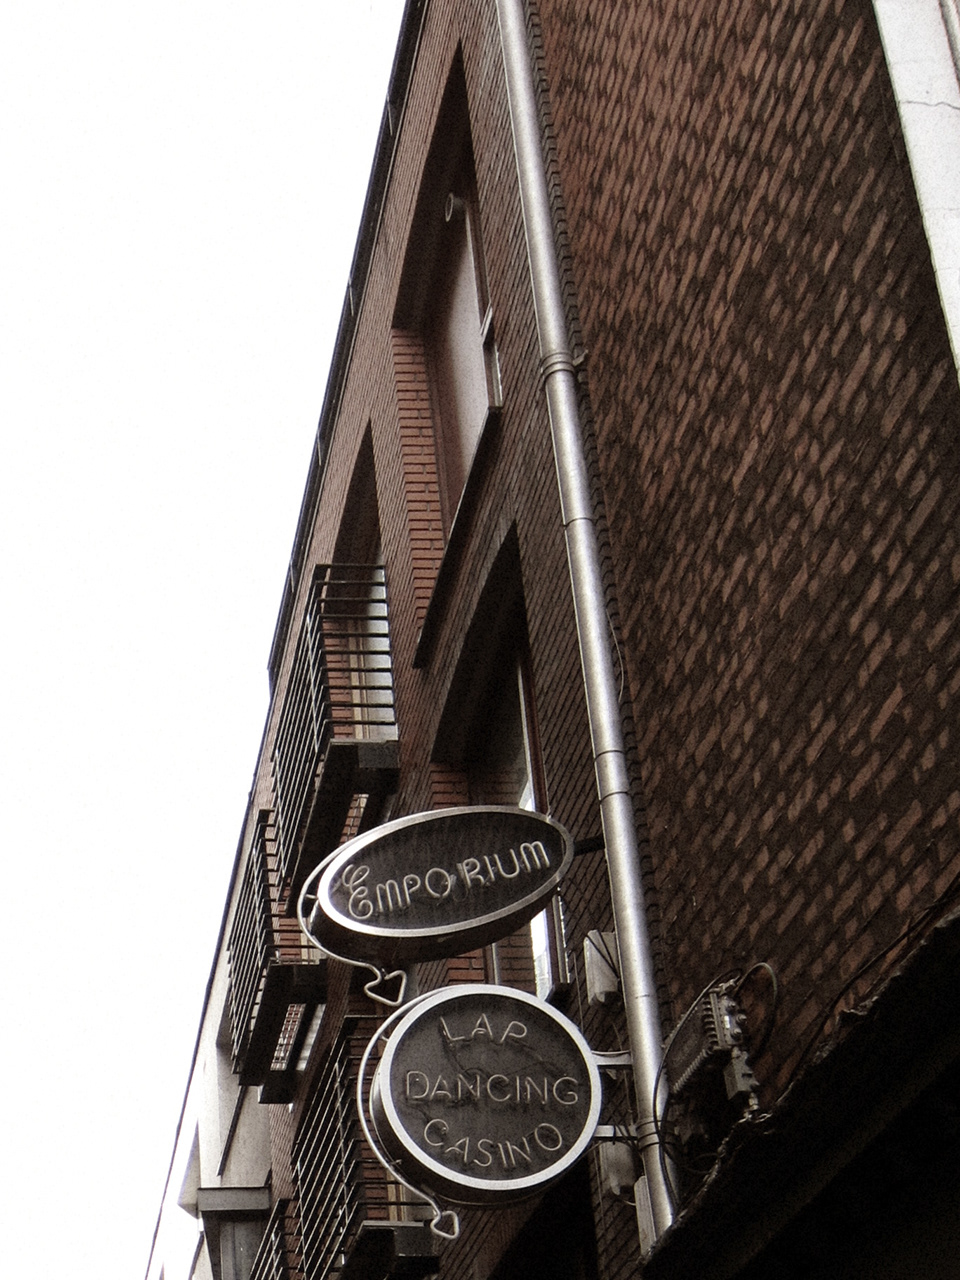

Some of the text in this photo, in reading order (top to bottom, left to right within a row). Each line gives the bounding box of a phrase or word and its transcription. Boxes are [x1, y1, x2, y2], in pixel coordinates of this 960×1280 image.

[341, 839, 551, 920] EMPORIUM
[440, 1012, 528, 1047] LAP
[405, 1070, 580, 1106] DANCING
[424, 1118, 563, 1169] CASINO
